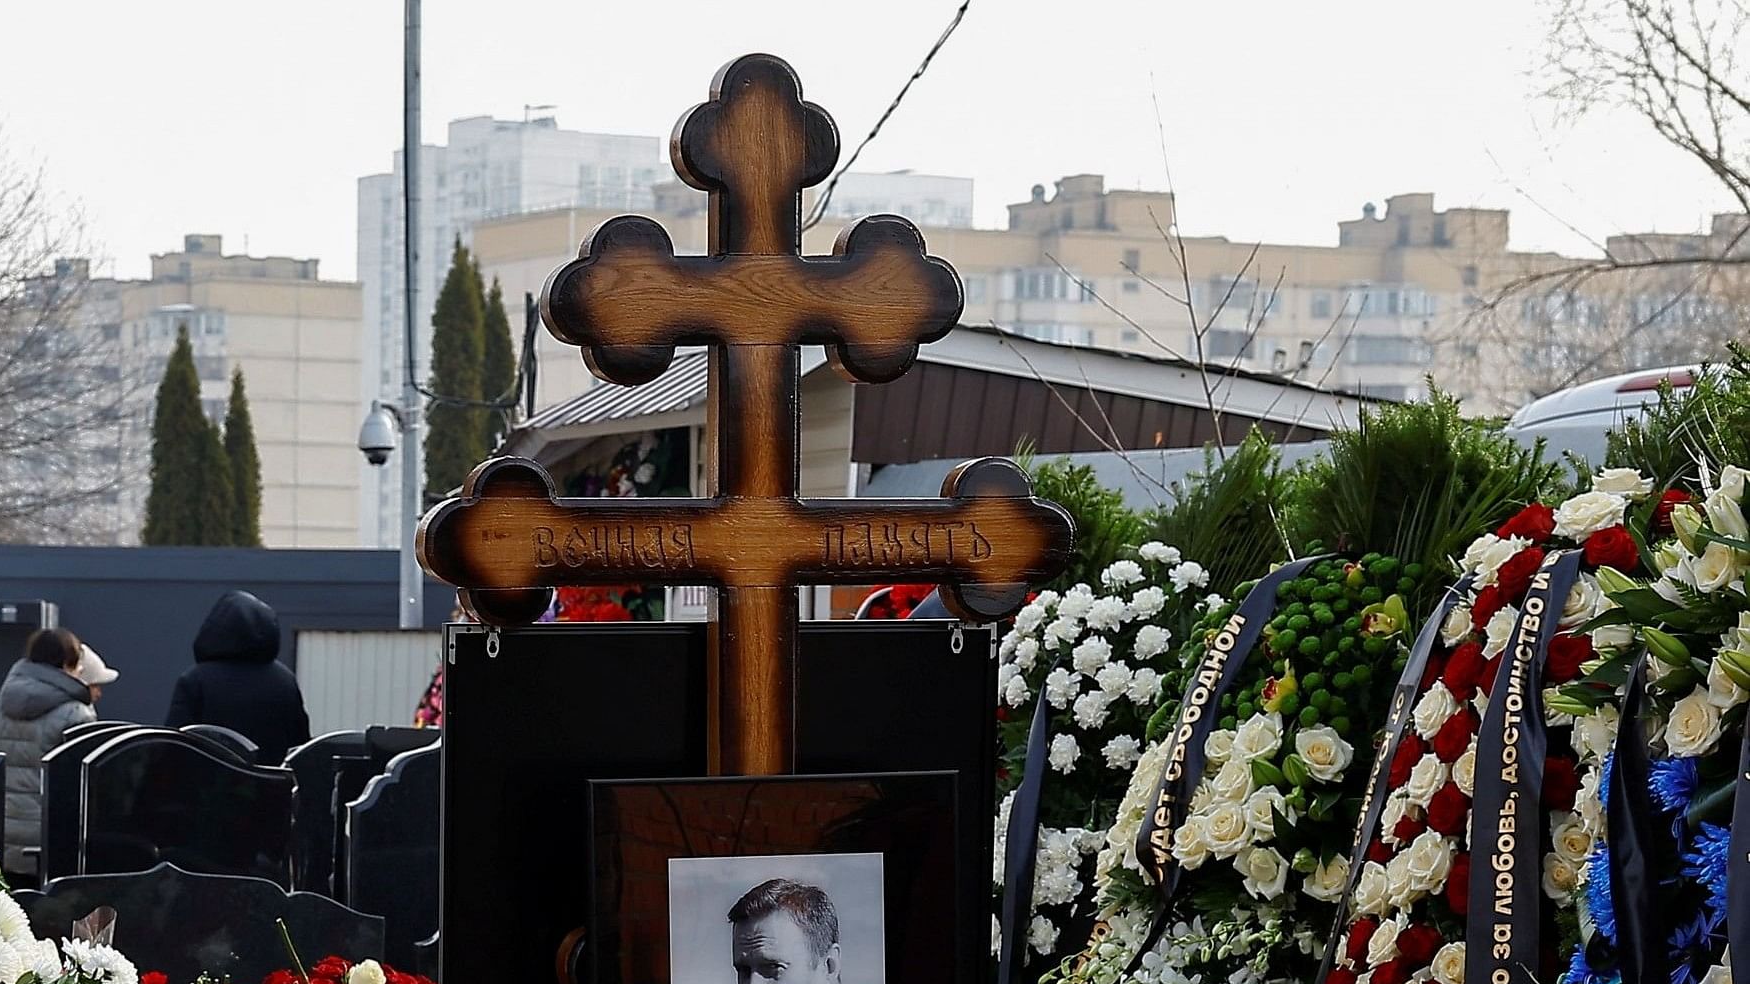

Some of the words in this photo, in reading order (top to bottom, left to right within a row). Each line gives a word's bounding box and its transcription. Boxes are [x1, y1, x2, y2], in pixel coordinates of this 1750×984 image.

[1531, 572, 1551, 589] и
[1501, 597, 1545, 784] достоинство
[1491, 792, 1520, 916] любовь,
[1493, 924, 1512, 960] за
